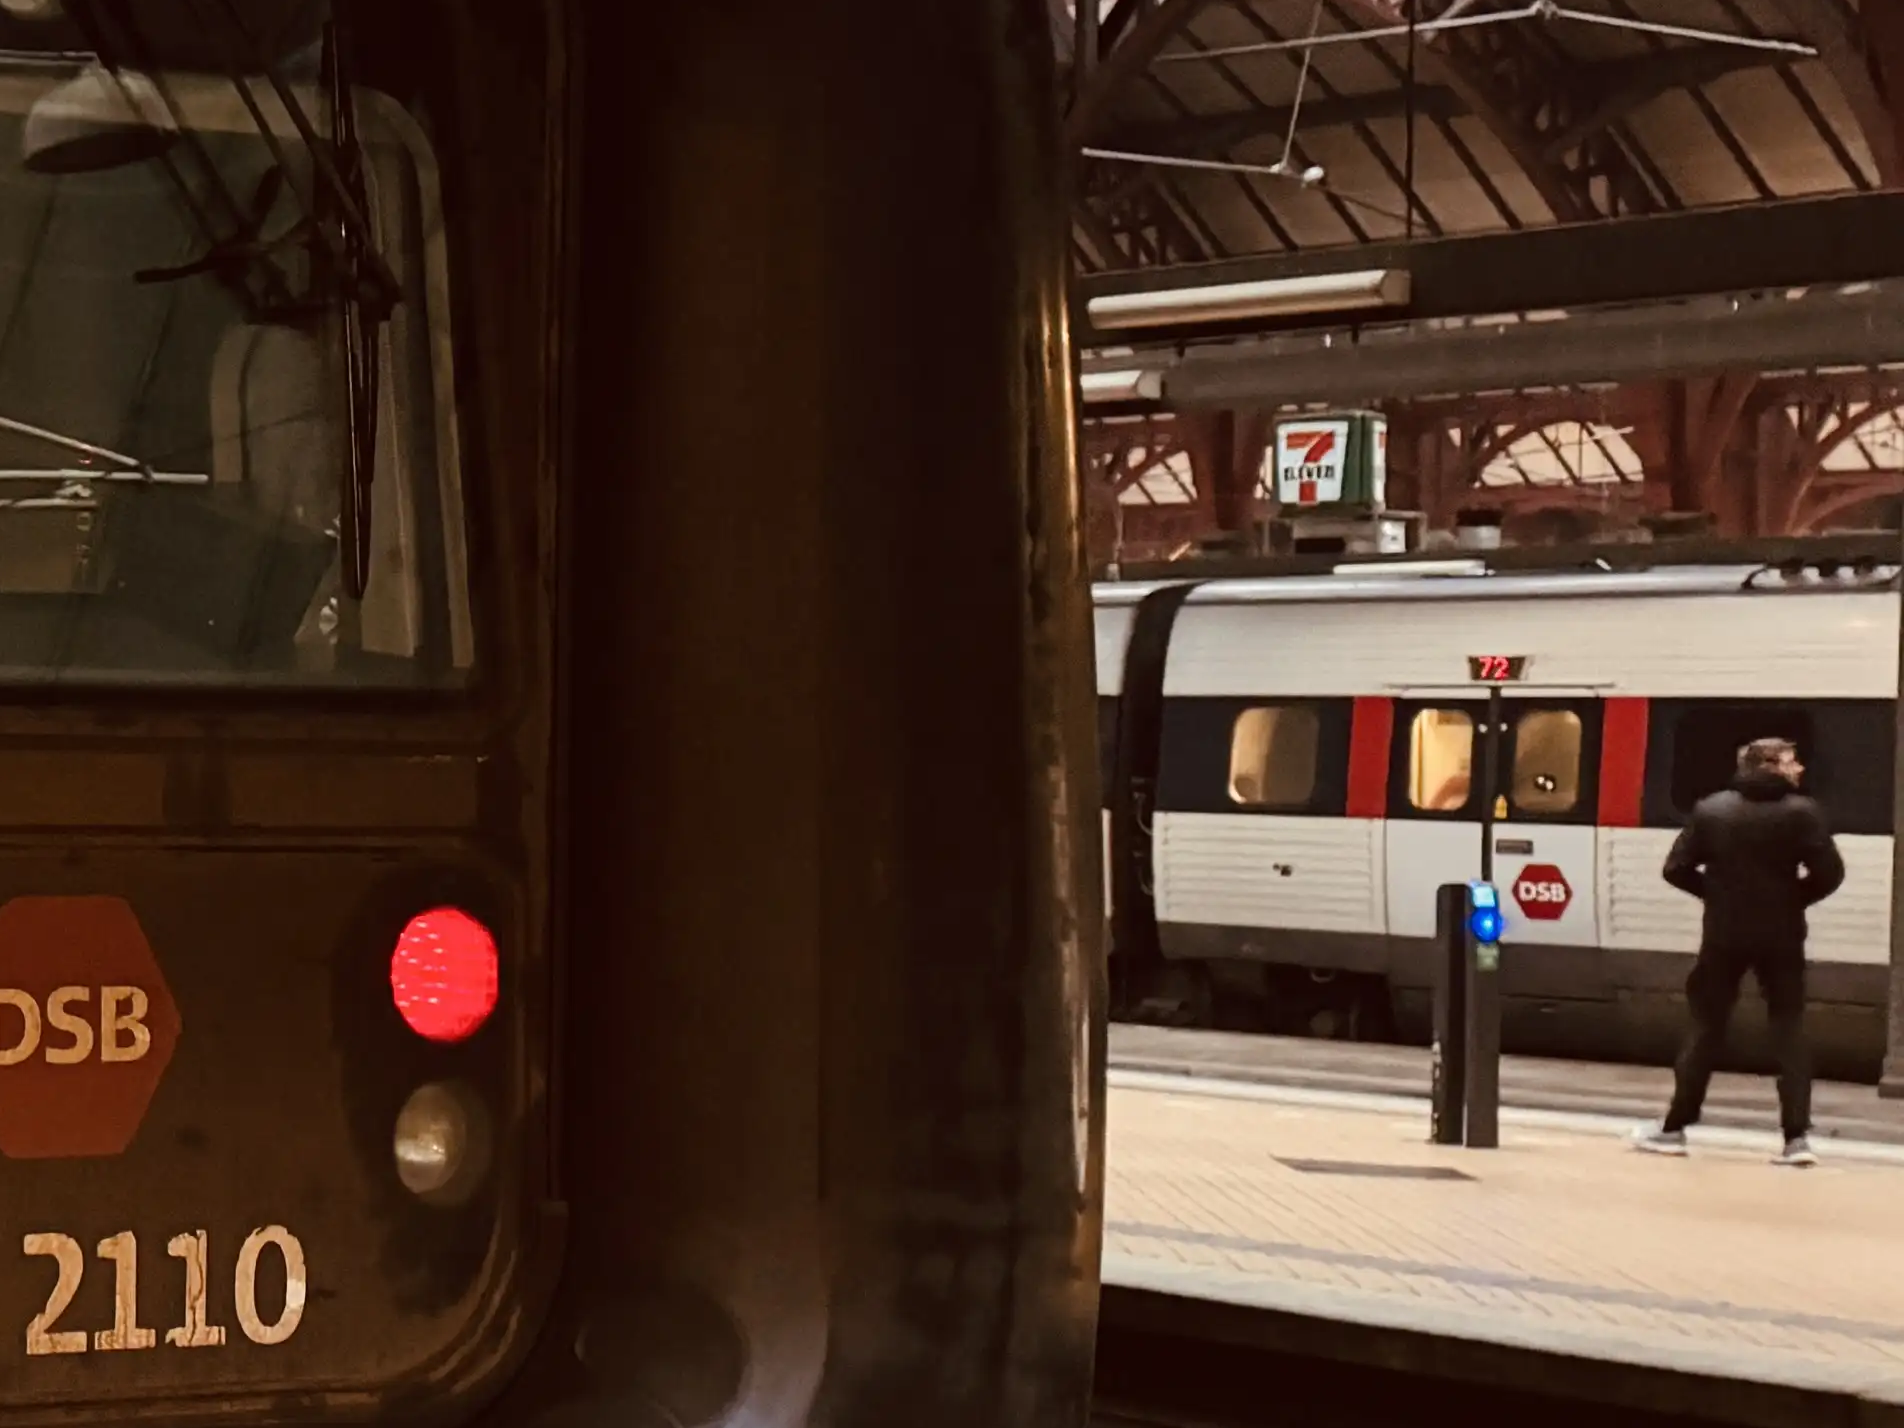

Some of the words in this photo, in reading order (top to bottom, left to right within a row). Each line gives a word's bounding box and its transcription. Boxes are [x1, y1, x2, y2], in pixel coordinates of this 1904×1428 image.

[1287, 430, 1335, 504] 7
[1479, 656, 1509, 680] 72
[1518, 880, 1566, 903] DSB
[22, 1224, 307, 1355] 2110
